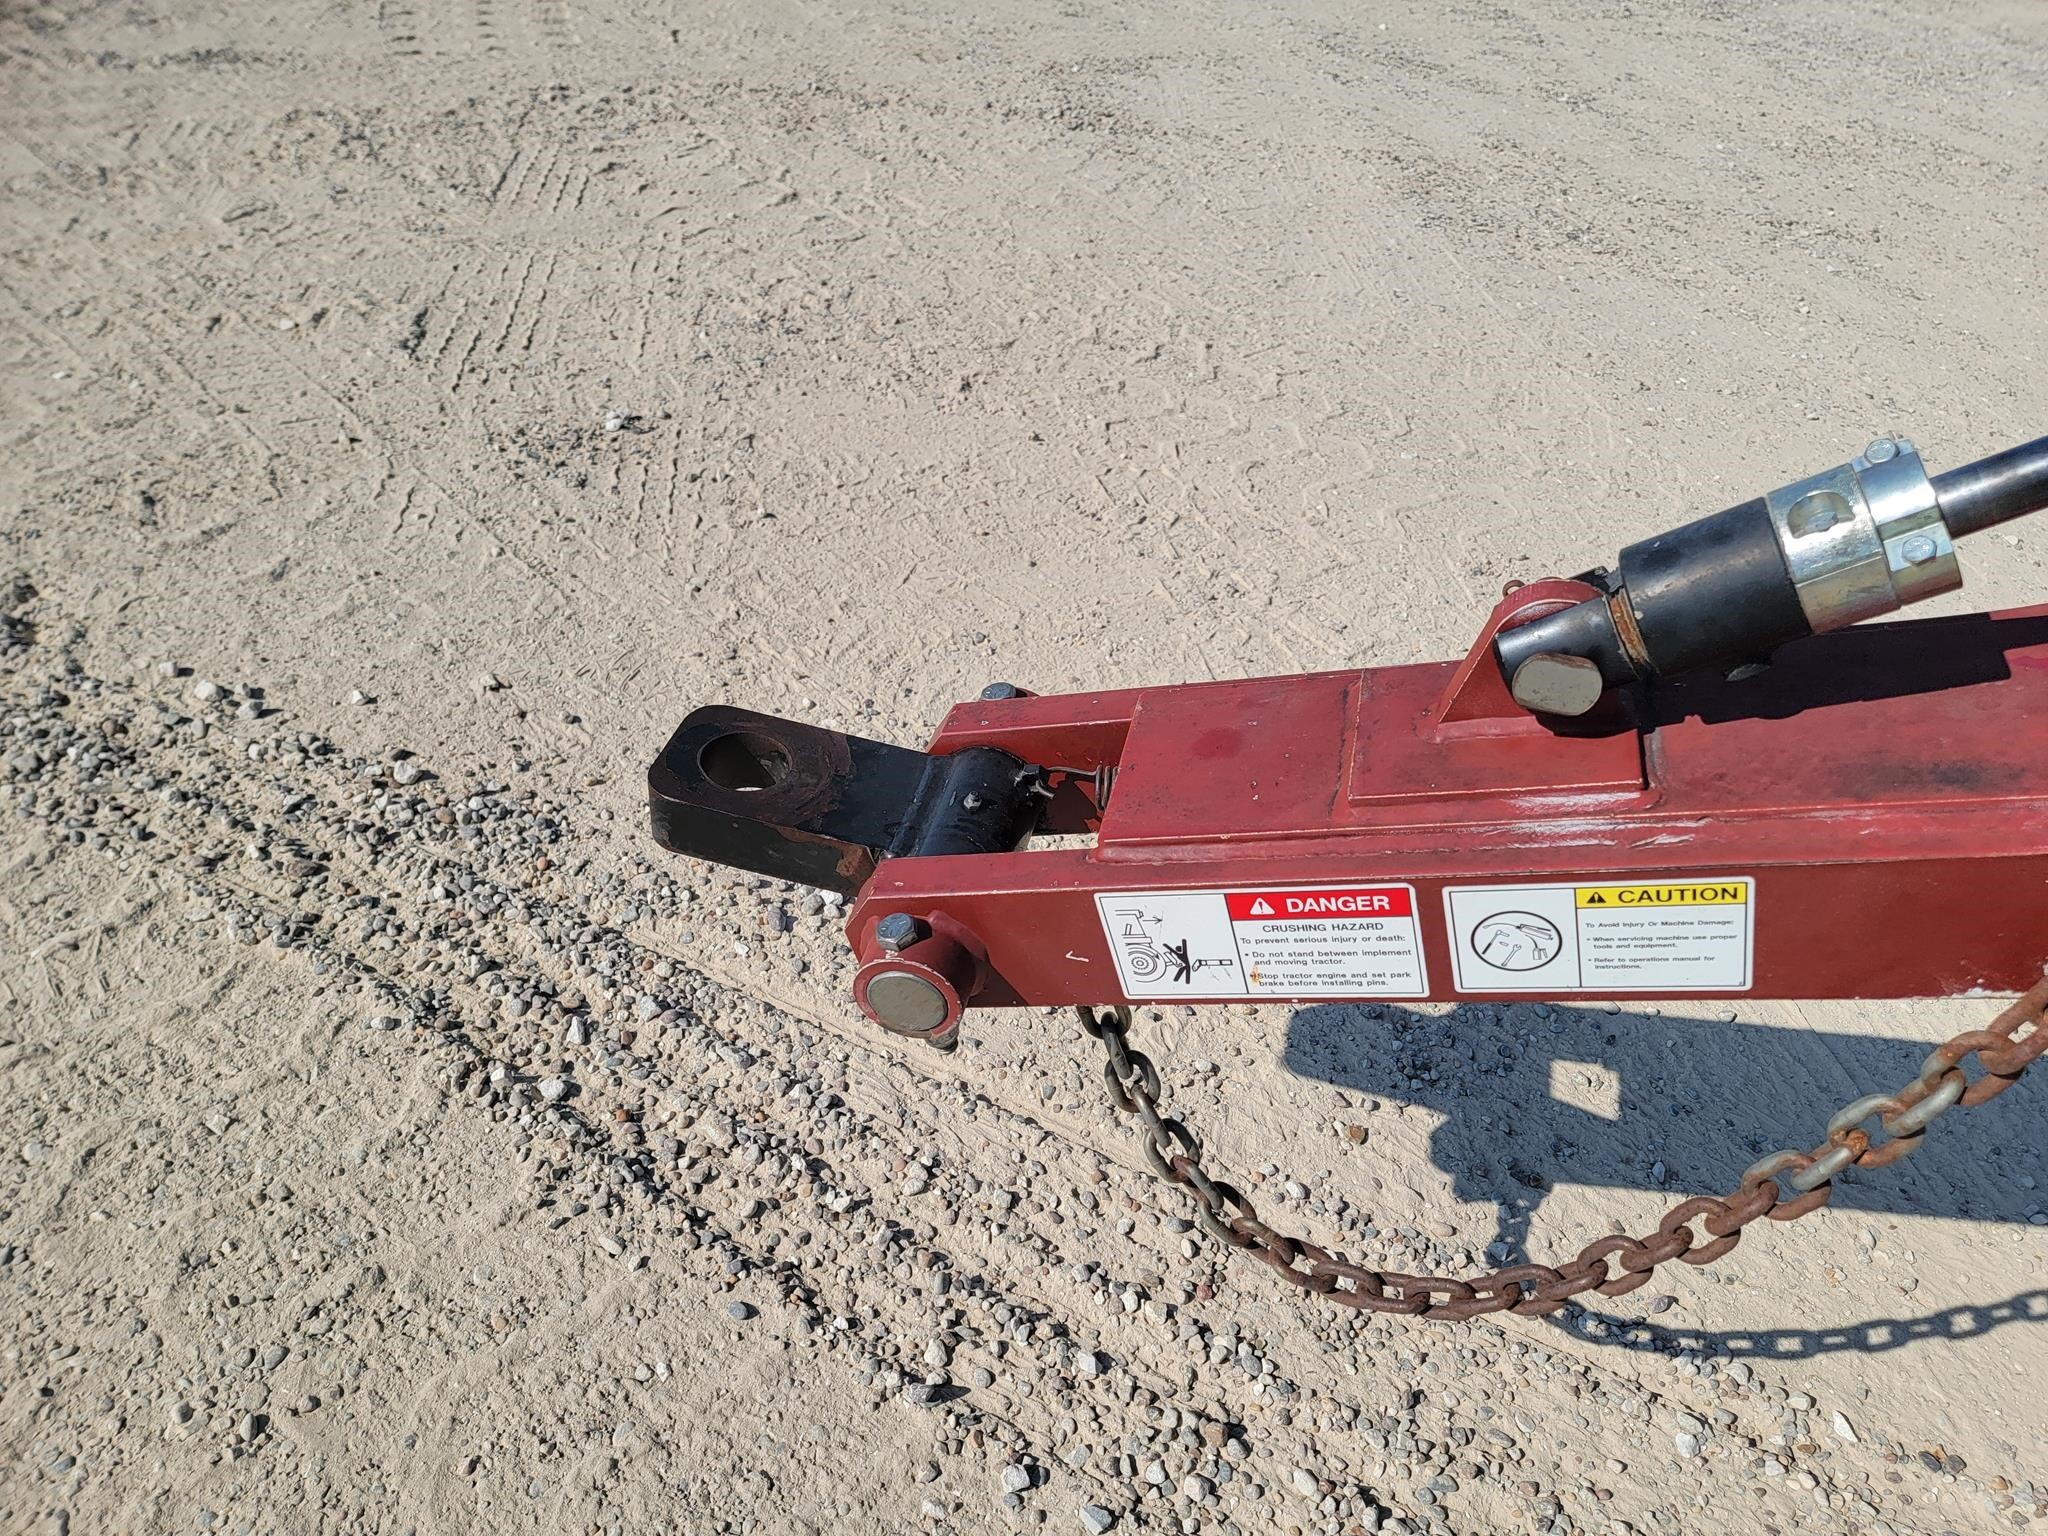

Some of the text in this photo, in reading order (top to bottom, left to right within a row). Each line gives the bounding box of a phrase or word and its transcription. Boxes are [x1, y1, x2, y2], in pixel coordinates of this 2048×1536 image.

[1618, 888, 1738, 903] CAUTION
[1286, 896, 1390, 912] DANGER
[1262, 923, 1384, 932] CRUSHING HAZARD
